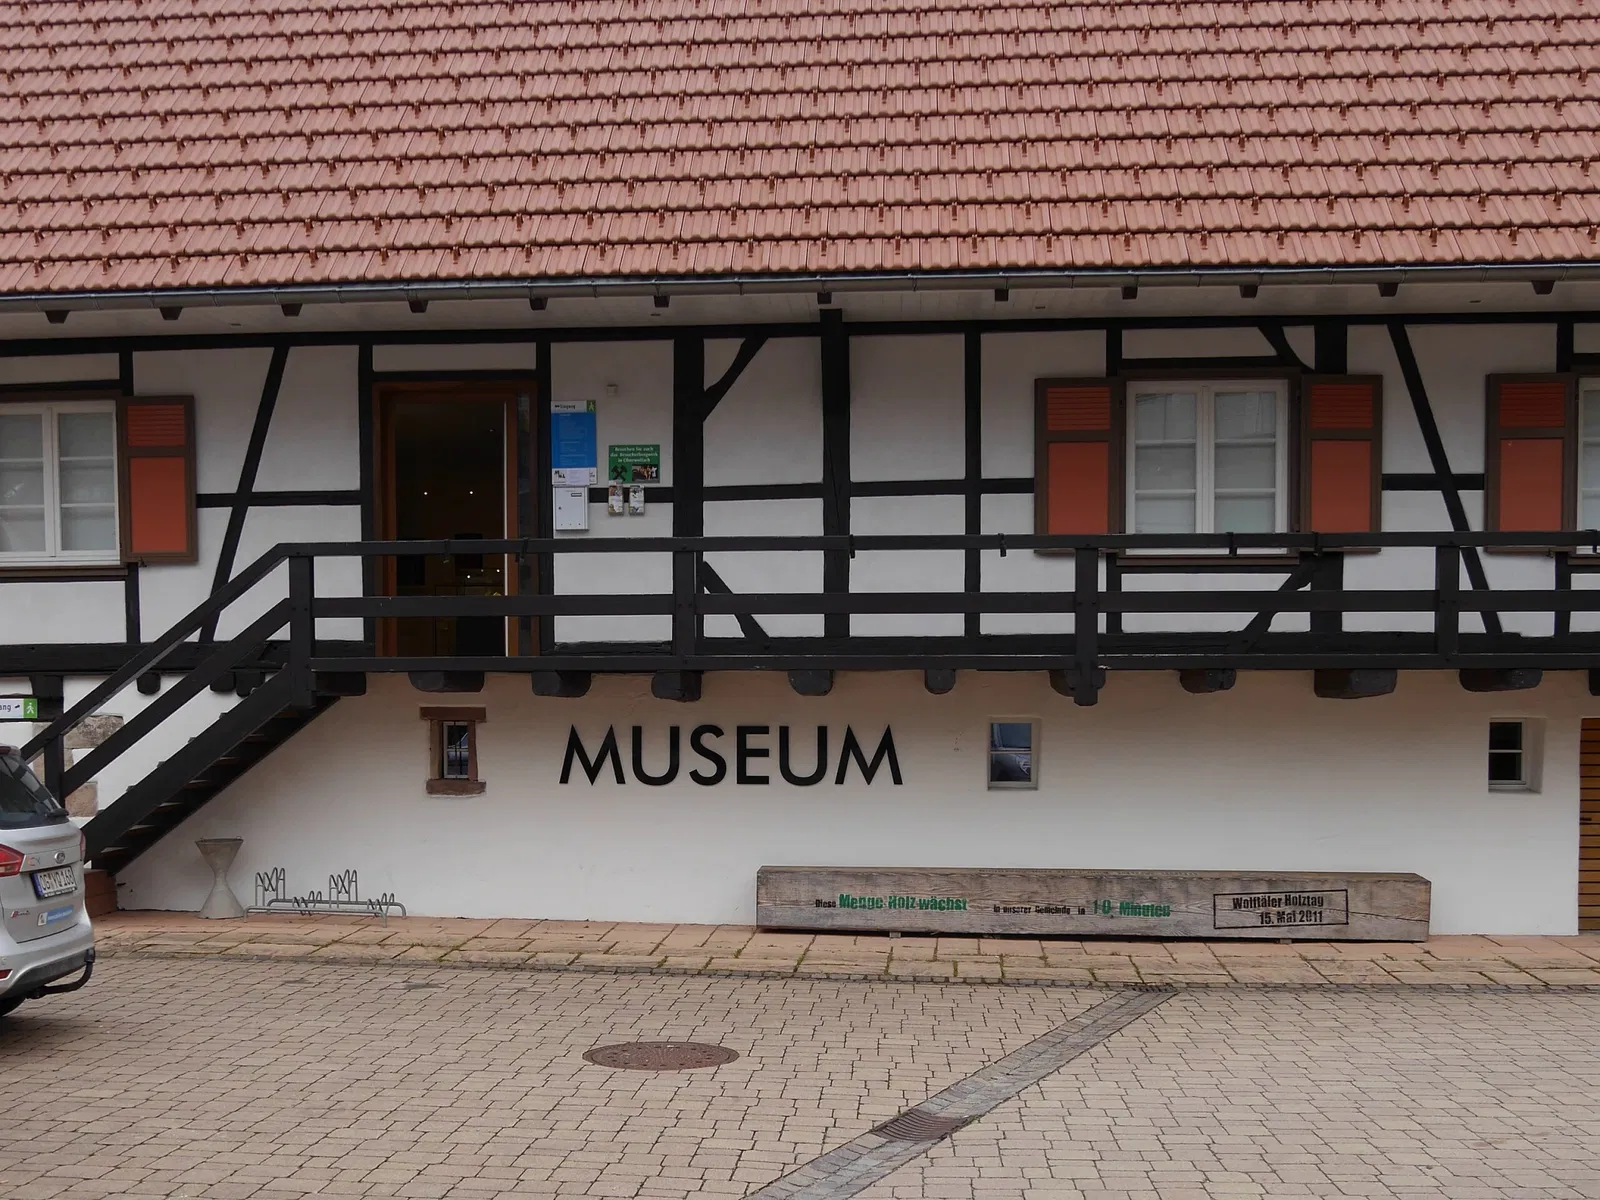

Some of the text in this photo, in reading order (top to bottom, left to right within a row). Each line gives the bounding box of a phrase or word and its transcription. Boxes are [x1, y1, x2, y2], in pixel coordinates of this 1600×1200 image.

[558, 723, 904, 787] MUSEUM
[815, 893, 969, 912] Diese Menge Holz wächst
[1003, 905, 1032, 914] unserer
[1119, 901, 1171, 918] Minuten
[1232, 894, 1324, 910] Wolftäler Holztag
[1260, 909, 1323, 925] 15. Mai 2011
